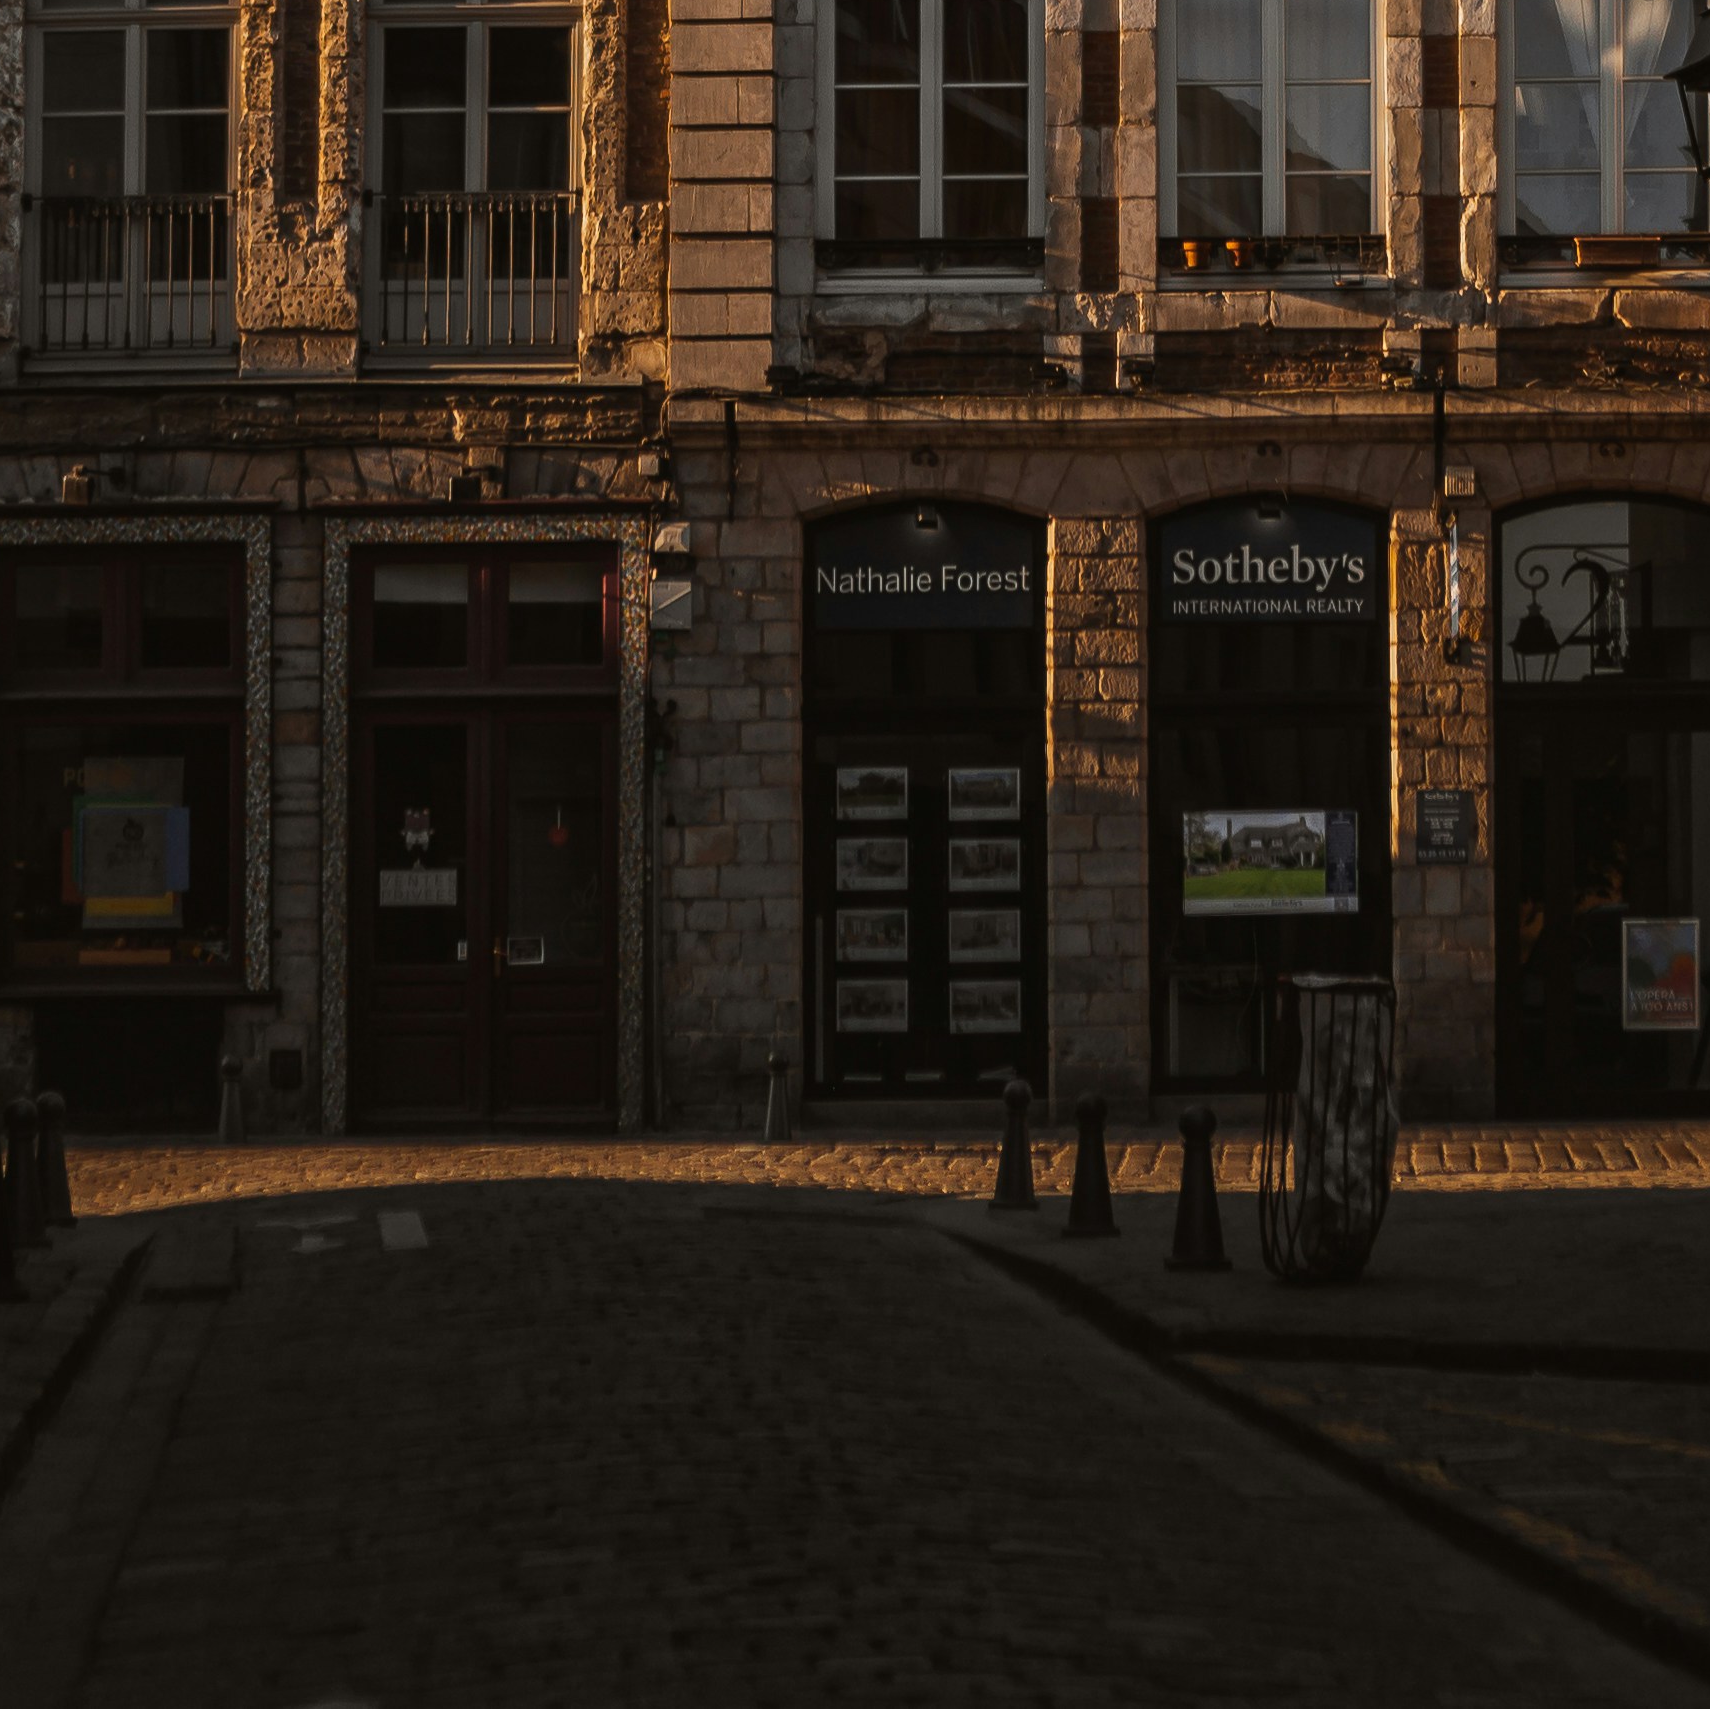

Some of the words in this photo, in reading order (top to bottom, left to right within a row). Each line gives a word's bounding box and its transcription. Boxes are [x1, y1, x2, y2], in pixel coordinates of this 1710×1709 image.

[816, 565, 932, 595] Nathalie
[941, 564, 1031, 593] Forest
[1172, 543, 1366, 593] Sotheby's
[1172, 599, 1302, 615] INTERNATIONAL
[1306, 597, 1365, 614] REALTY
